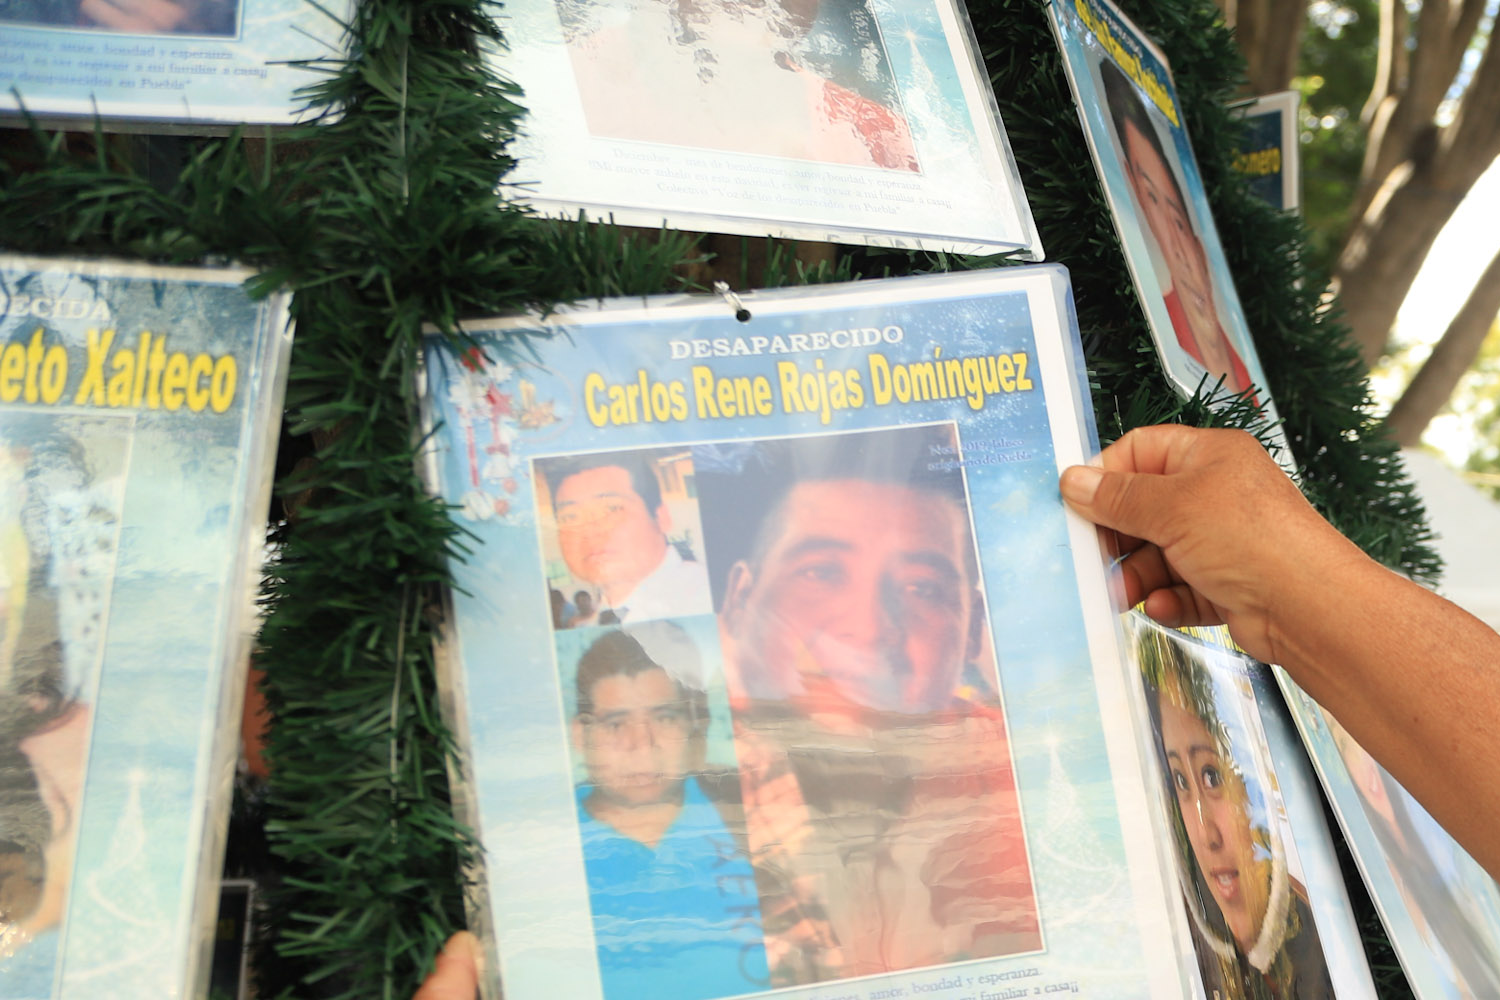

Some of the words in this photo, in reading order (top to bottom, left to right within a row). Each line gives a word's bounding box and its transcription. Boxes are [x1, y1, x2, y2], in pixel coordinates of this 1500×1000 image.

[669, 325, 904, 360] DESAPARECIDO
[0, 327, 68, 405] eto
[73, 327, 238, 414] Xalteco
[584, 368, 689, 428] Carlos
[692, 364, 773, 419] Rene
[777, 358, 865, 425] Rojas
[868, 346, 1034, 410] Domínguez
[912, 975, 963, 994] bondad
[966, 976, 975, 989] y
[1033, 985, 1042, 996] a
